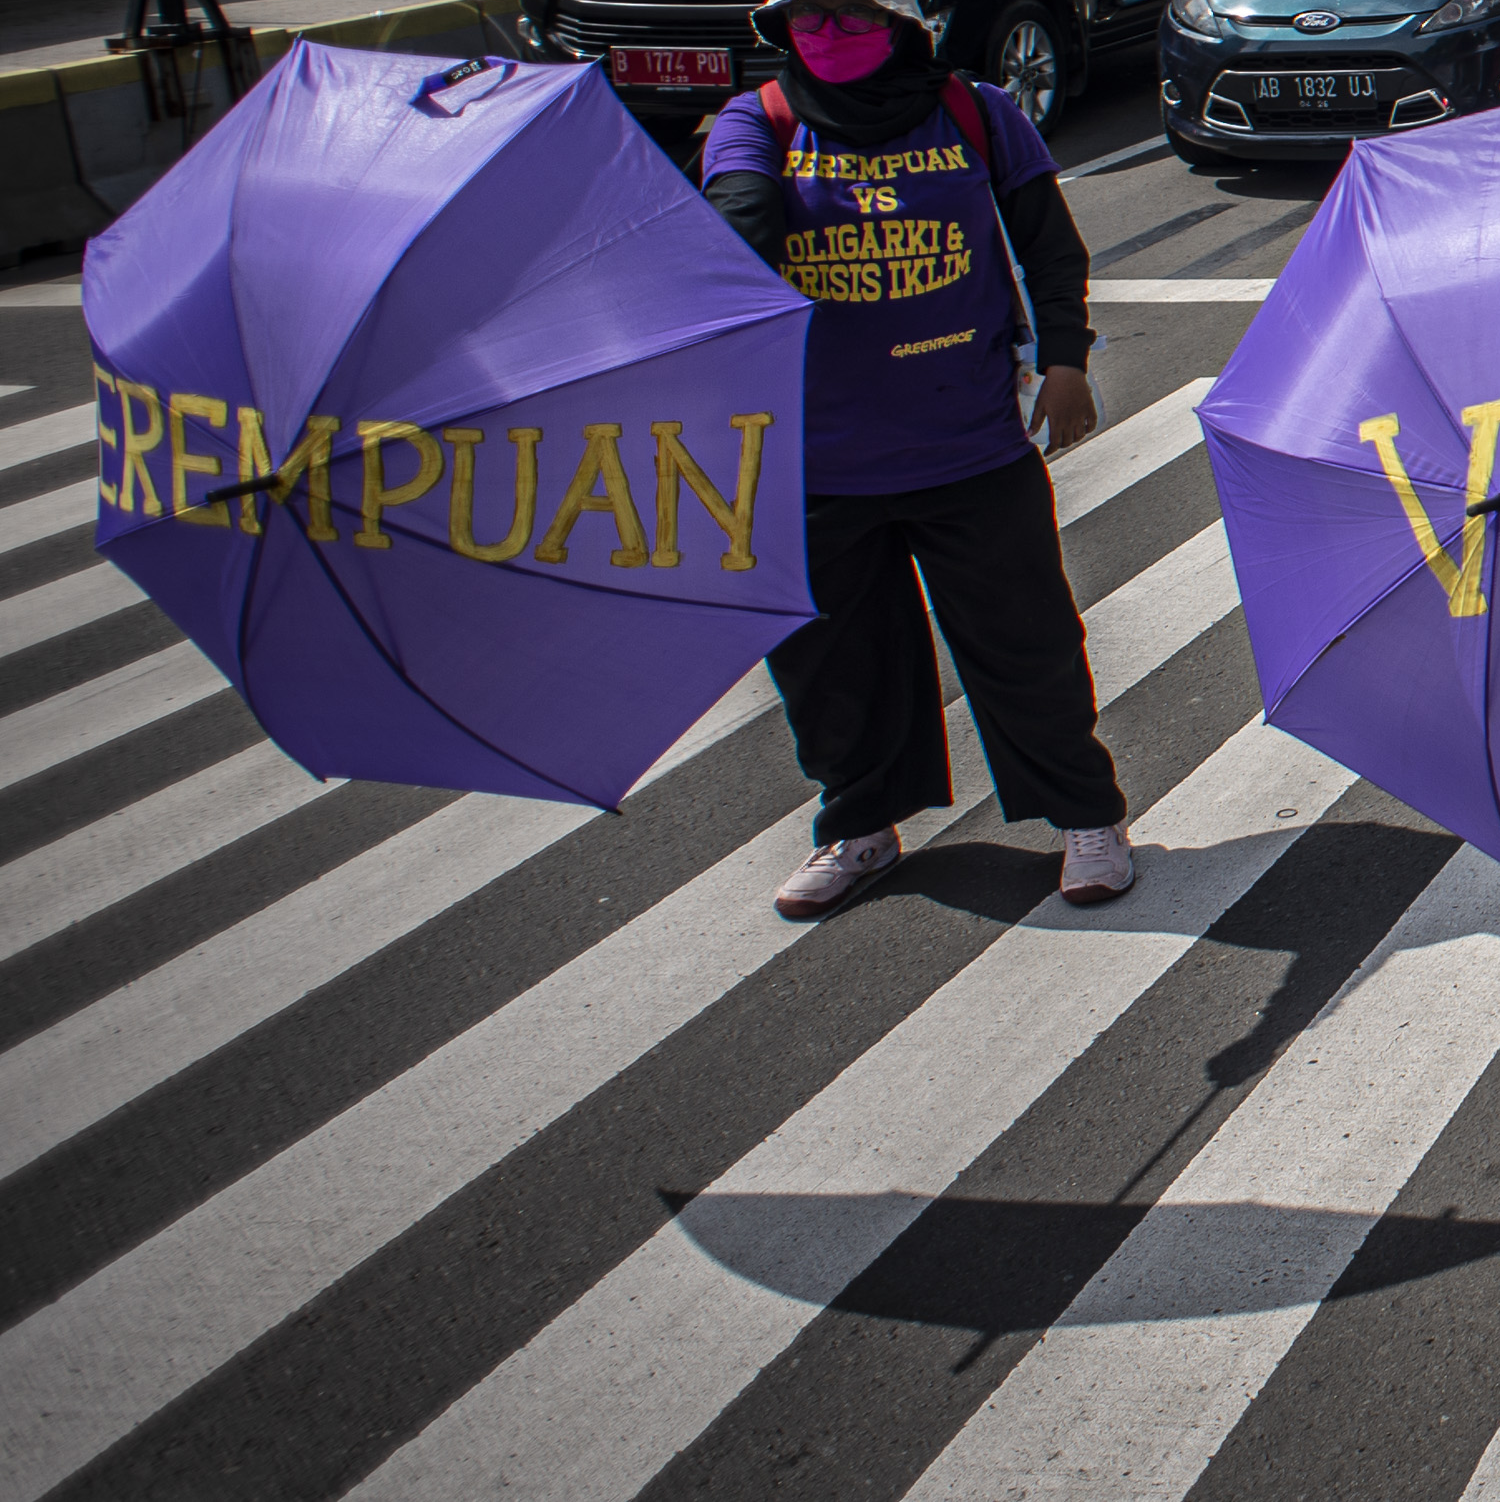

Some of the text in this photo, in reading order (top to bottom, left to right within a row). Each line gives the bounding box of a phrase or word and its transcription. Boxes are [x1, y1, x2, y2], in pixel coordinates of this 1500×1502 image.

[1302, 14, 1329, 27] Ford
[616, 51, 628, 73] B
[1259, 75, 1374, 98] AB 1832 UJ
[782, 145, 969, 181] PEREMPUAN
[852, 186, 898, 213] VS
[785, 220, 964, 263] OLIGARKI &
[780, 249, 972, 302] KRISIS IKLIM
[891, 329, 976, 357] GREENPEACE
